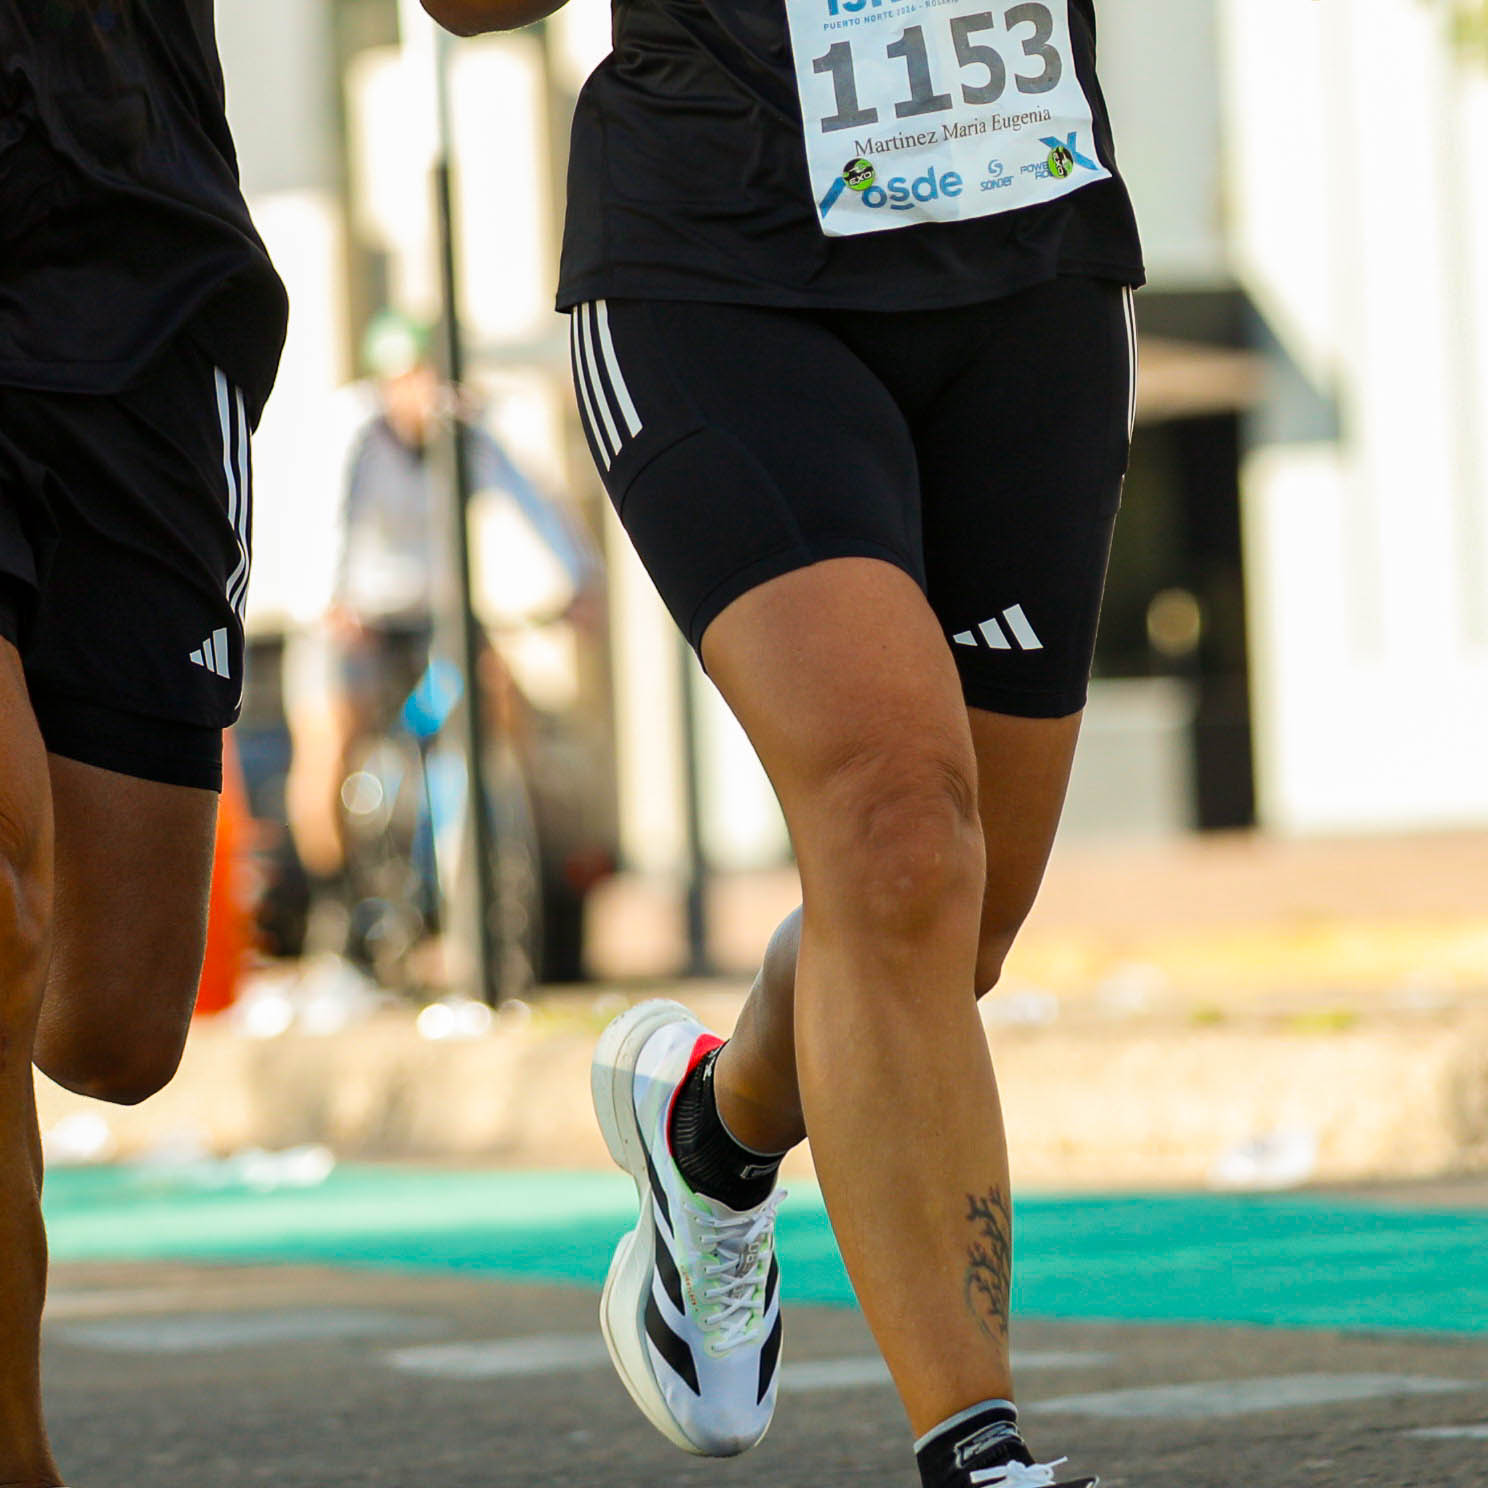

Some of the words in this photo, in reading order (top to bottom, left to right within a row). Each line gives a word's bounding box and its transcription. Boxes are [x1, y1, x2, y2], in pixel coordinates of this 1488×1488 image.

[823, 18, 860, 31] PUERTO
[863, 10, 893, 23] NORTE
[812, 1, 1062, 133] 1153
[854, 131, 938, 156] Martinez
[941, 117, 986, 141] Maria
[992, 106, 1052, 131] Eugenia
[849, 172, 871, 186] EXO
[1020, 161, 1050, 174] POWE
[862, 166, 963, 209] osde
